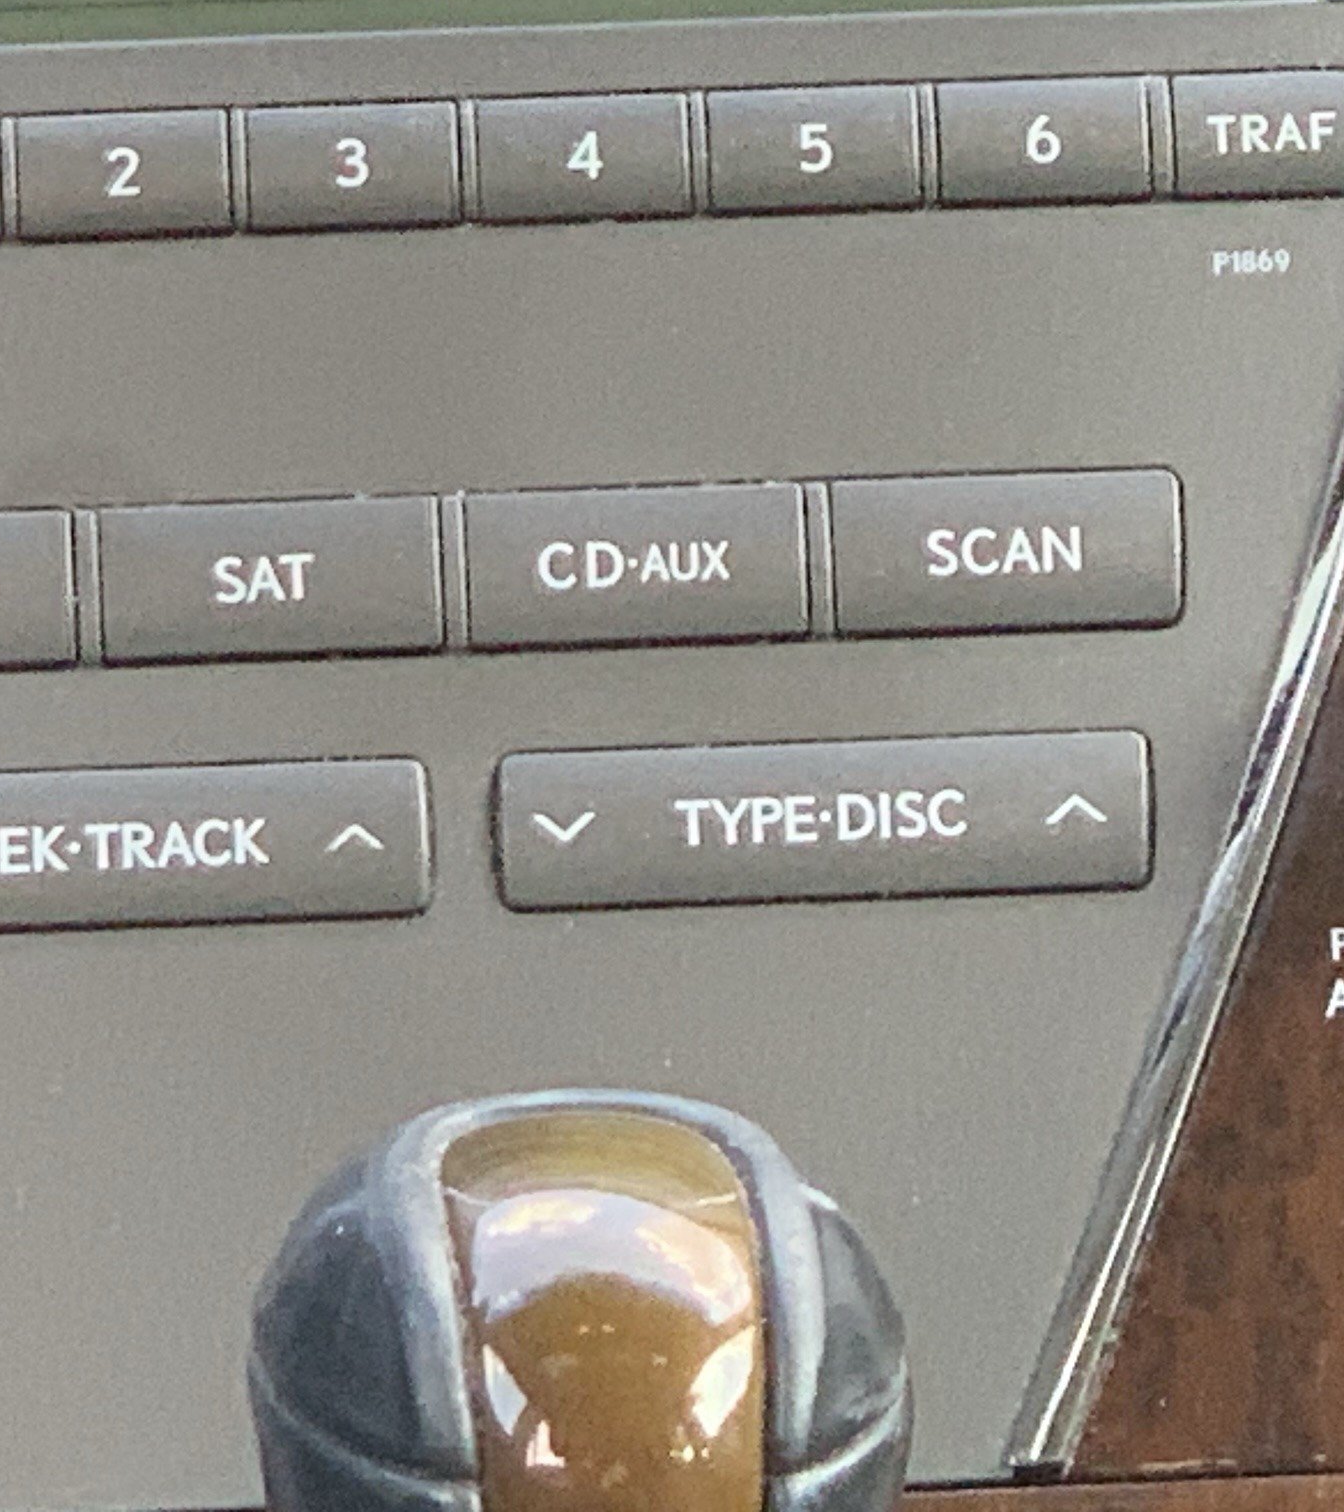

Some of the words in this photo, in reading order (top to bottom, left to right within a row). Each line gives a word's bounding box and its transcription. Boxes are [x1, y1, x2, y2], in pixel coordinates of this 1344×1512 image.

[567, 131, 603, 179] 4
[800, 123, 832, 173] 5
[1026, 114, 1061, 163] 6
[1206, 111, 1337, 154] TRAF
[107, 147, 140, 196] 2
[335, 138, 369, 187] 3
[1213, 248, 1290, 276] P1869
[927, 526, 1082, 576] SCAN
[213, 553, 314, 604] SAT
